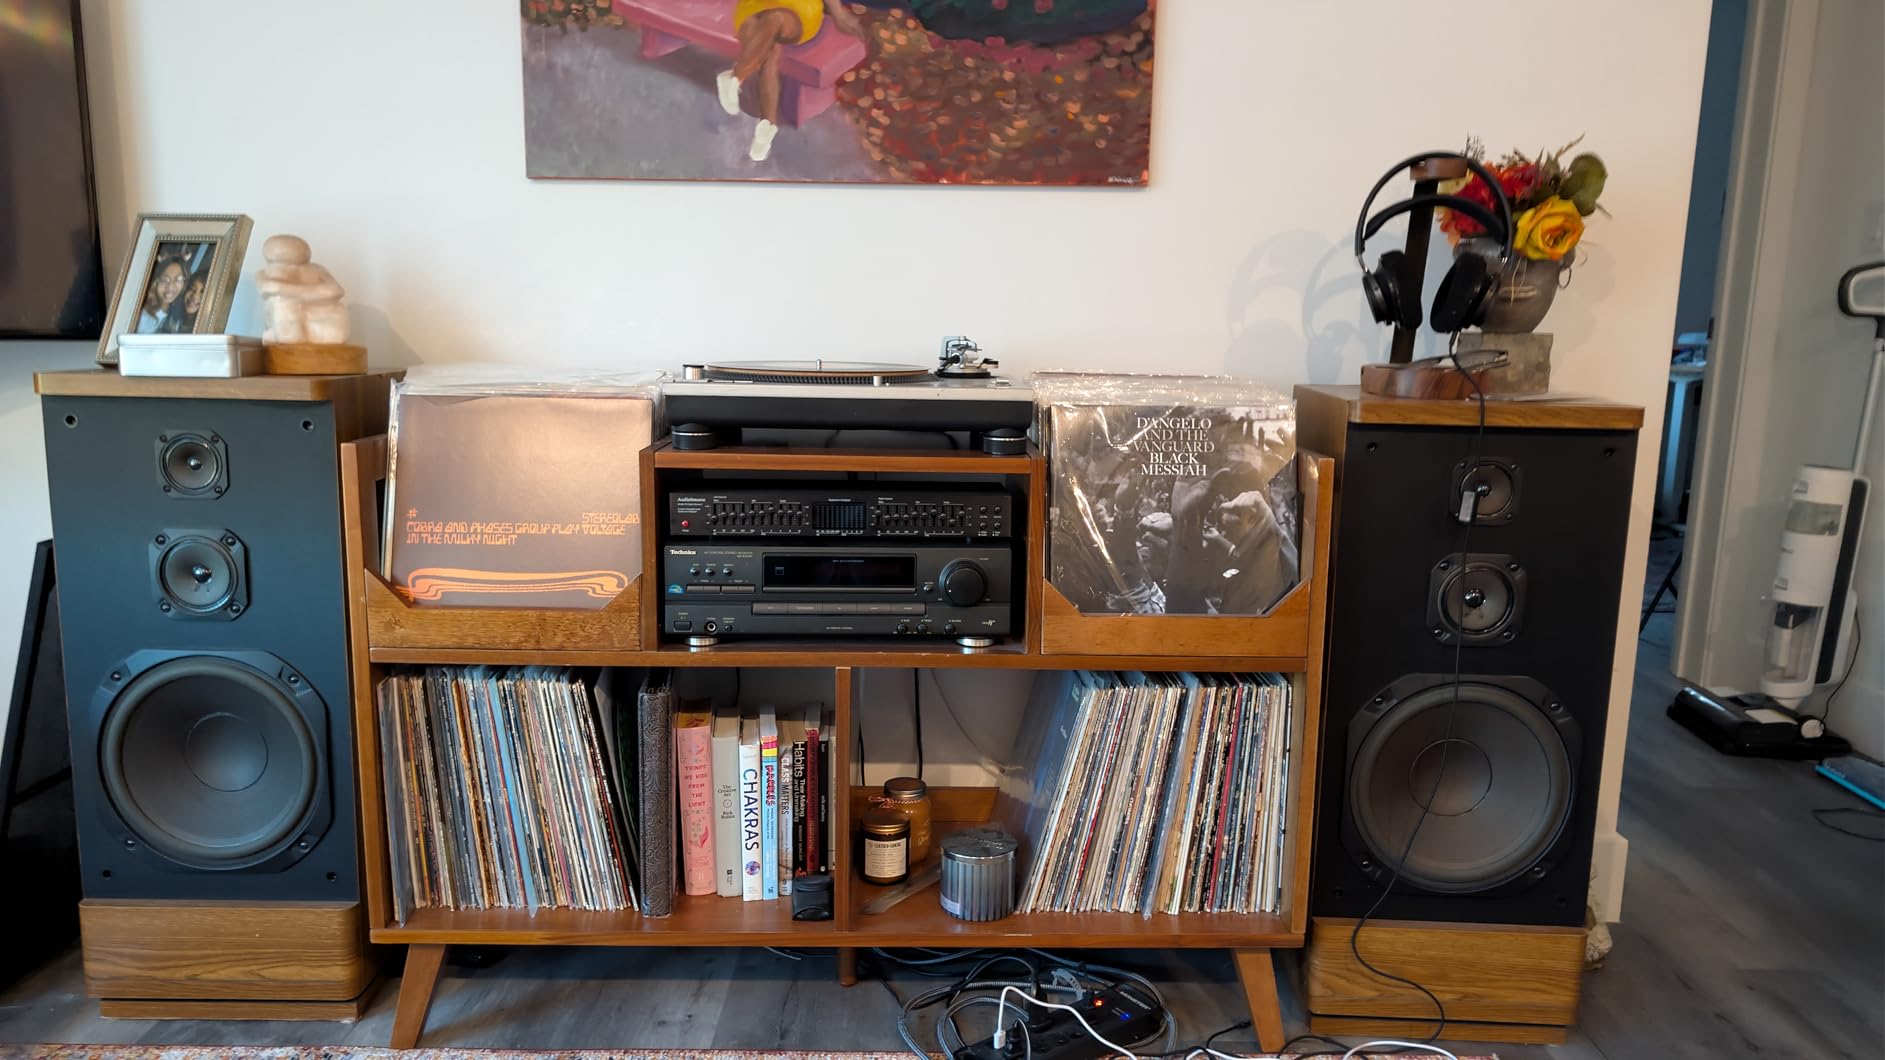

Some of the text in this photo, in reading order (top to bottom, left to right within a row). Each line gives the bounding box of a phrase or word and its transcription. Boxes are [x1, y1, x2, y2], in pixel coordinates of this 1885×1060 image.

[1136, 417, 1212, 430] D'ANGELO
[1142, 430, 1209, 441] AND THE
[1133, 440, 1215, 453] VANGUARD
[1149, 452, 1198, 464] BLACK
[1141, 463, 1208, 476] MESSIAH
[581, 512, 640, 524] STEREOLAB
[406, 521, 626, 535] COBRA AND PHASES GROUP PLAY VOLTAGE
[406, 533, 518, 546] IN THE MILKY NIGHT
[794, 741, 805, 777] Habits
[781, 757, 789, 782] CLASS
[781, 784, 789, 815] MATTERS
[742, 768, 760, 852] CHAKRAS
